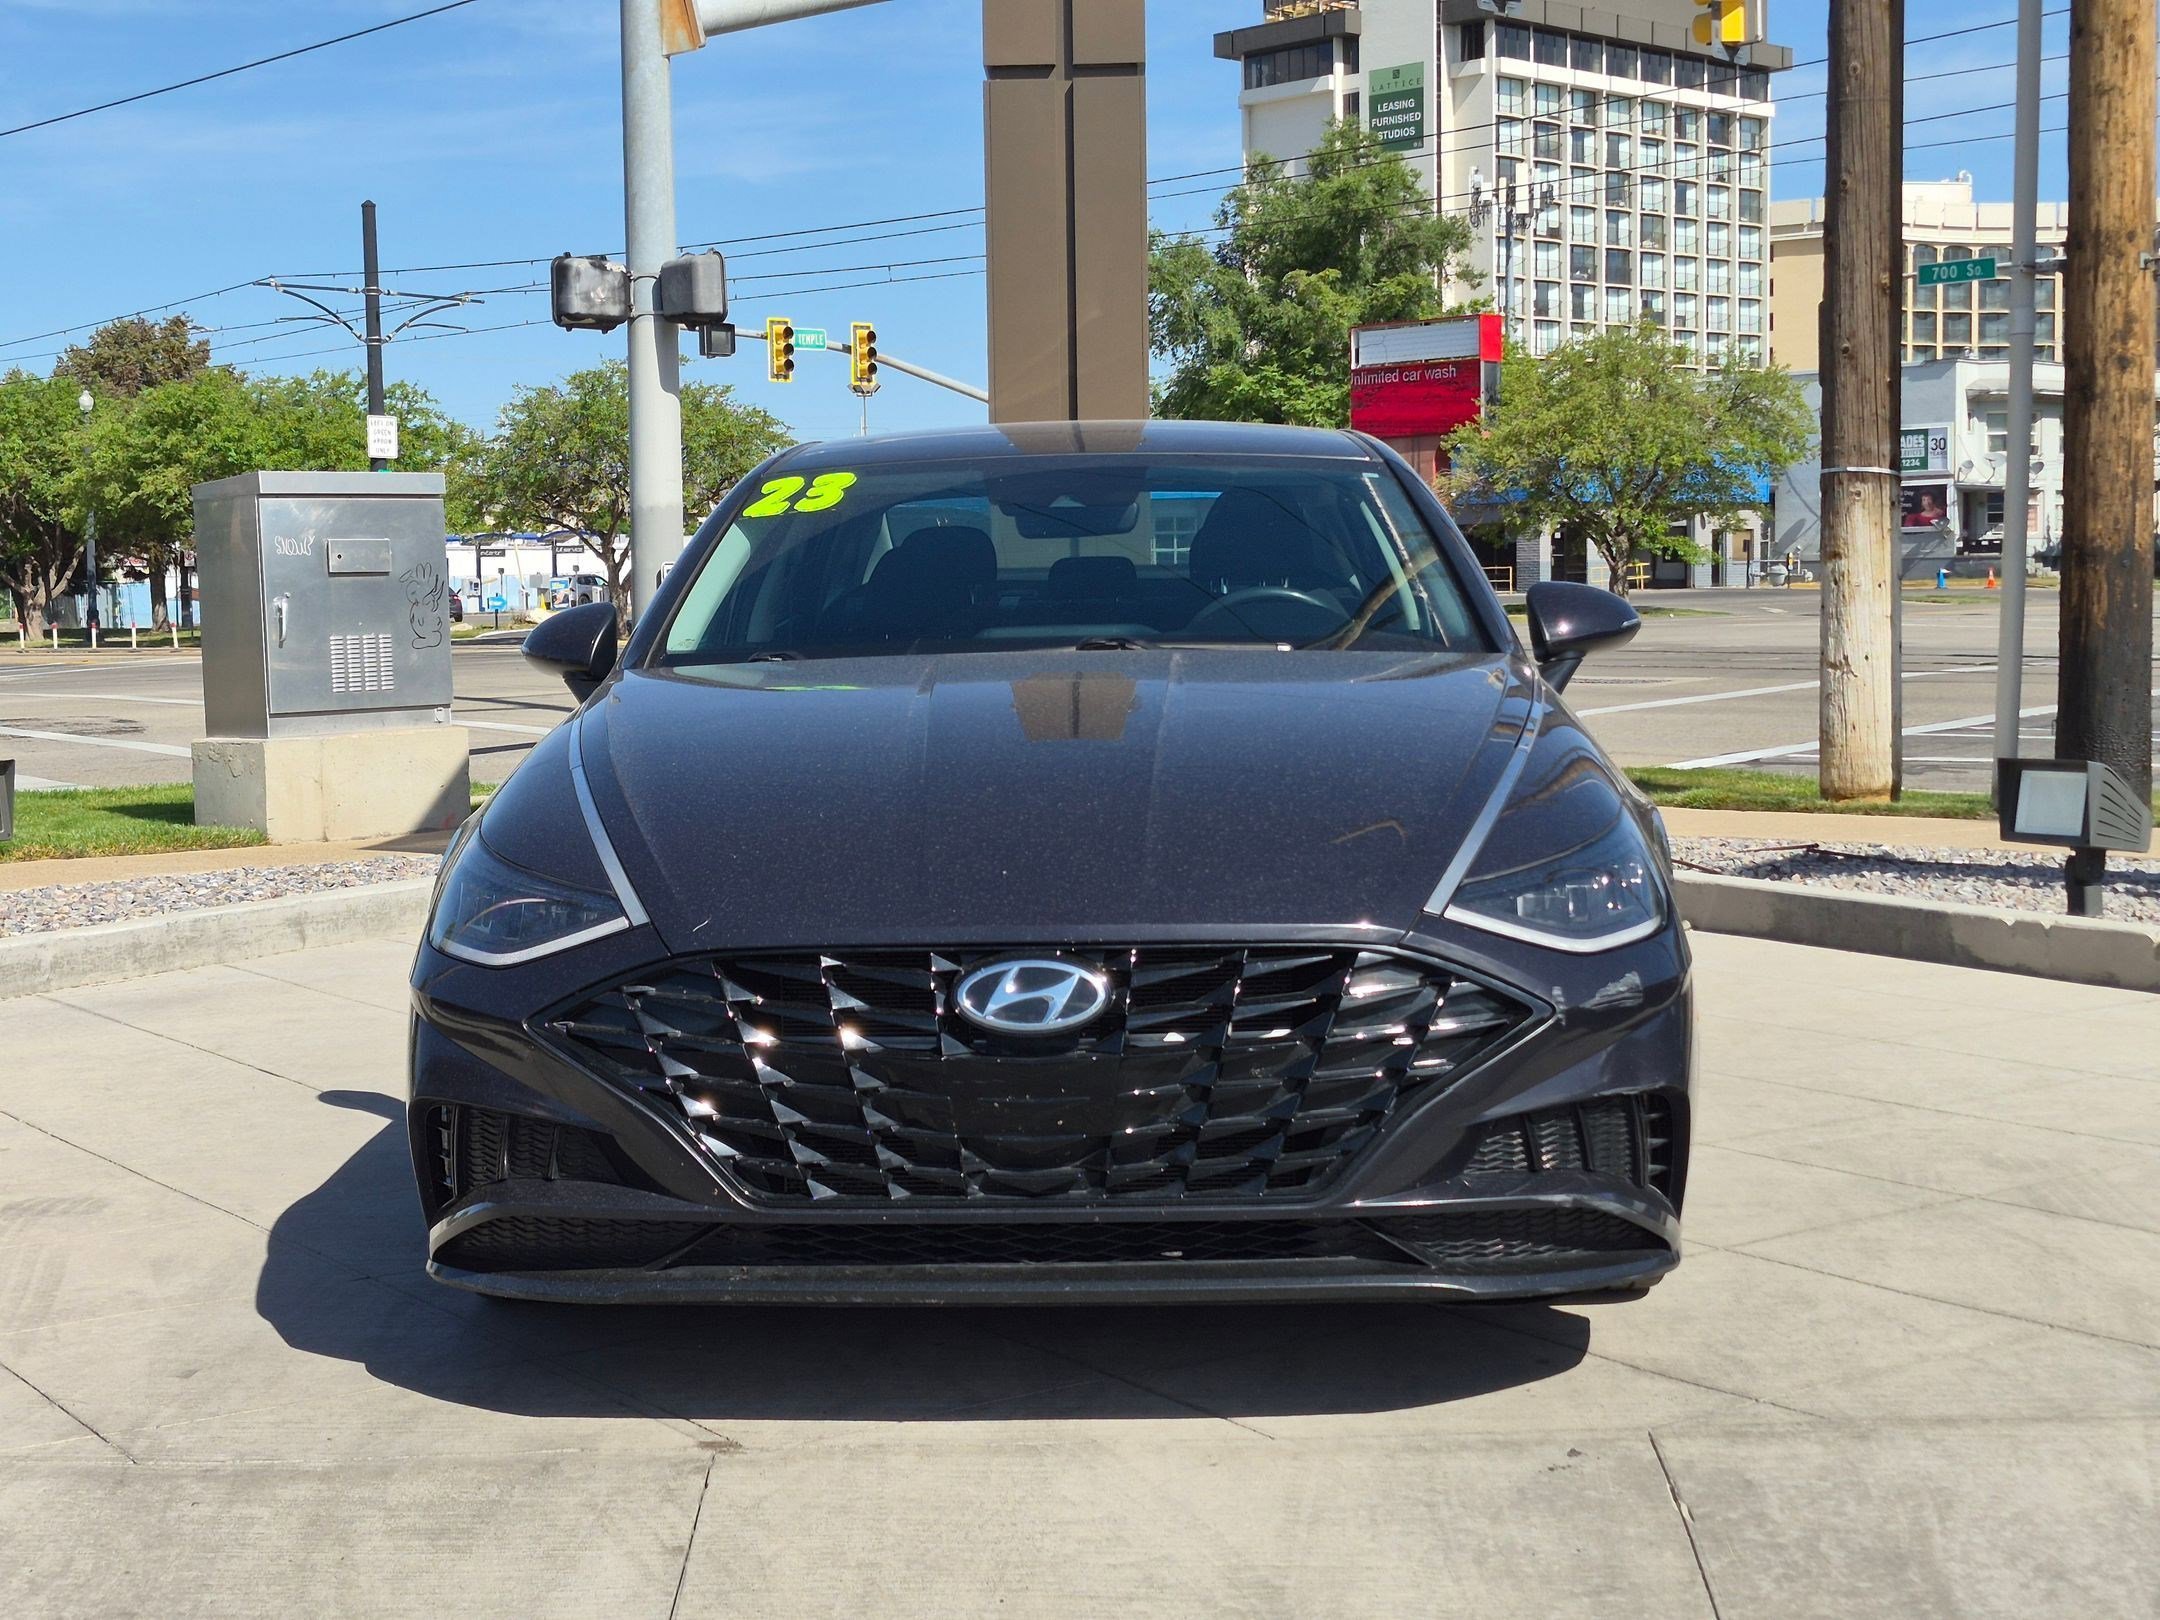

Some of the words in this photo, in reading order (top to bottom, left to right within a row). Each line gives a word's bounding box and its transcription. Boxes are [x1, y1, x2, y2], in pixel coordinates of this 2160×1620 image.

[1371, 77, 1422, 92] LATTICE
[1377, 98, 1416, 112] LEASING
[1371, 112, 1422, 128] FURNISHED
[1377, 126, 1416, 141] STUDIOS
[1931, 265, 1958, 280] 700
[797, 333, 824, 346] TEMPLE
[1402, 370, 1421, 382] car
[1424, 364, 1457, 380] wash
[1930, 438, 1947, 451] 30
[742, 472, 858, 518] 23
